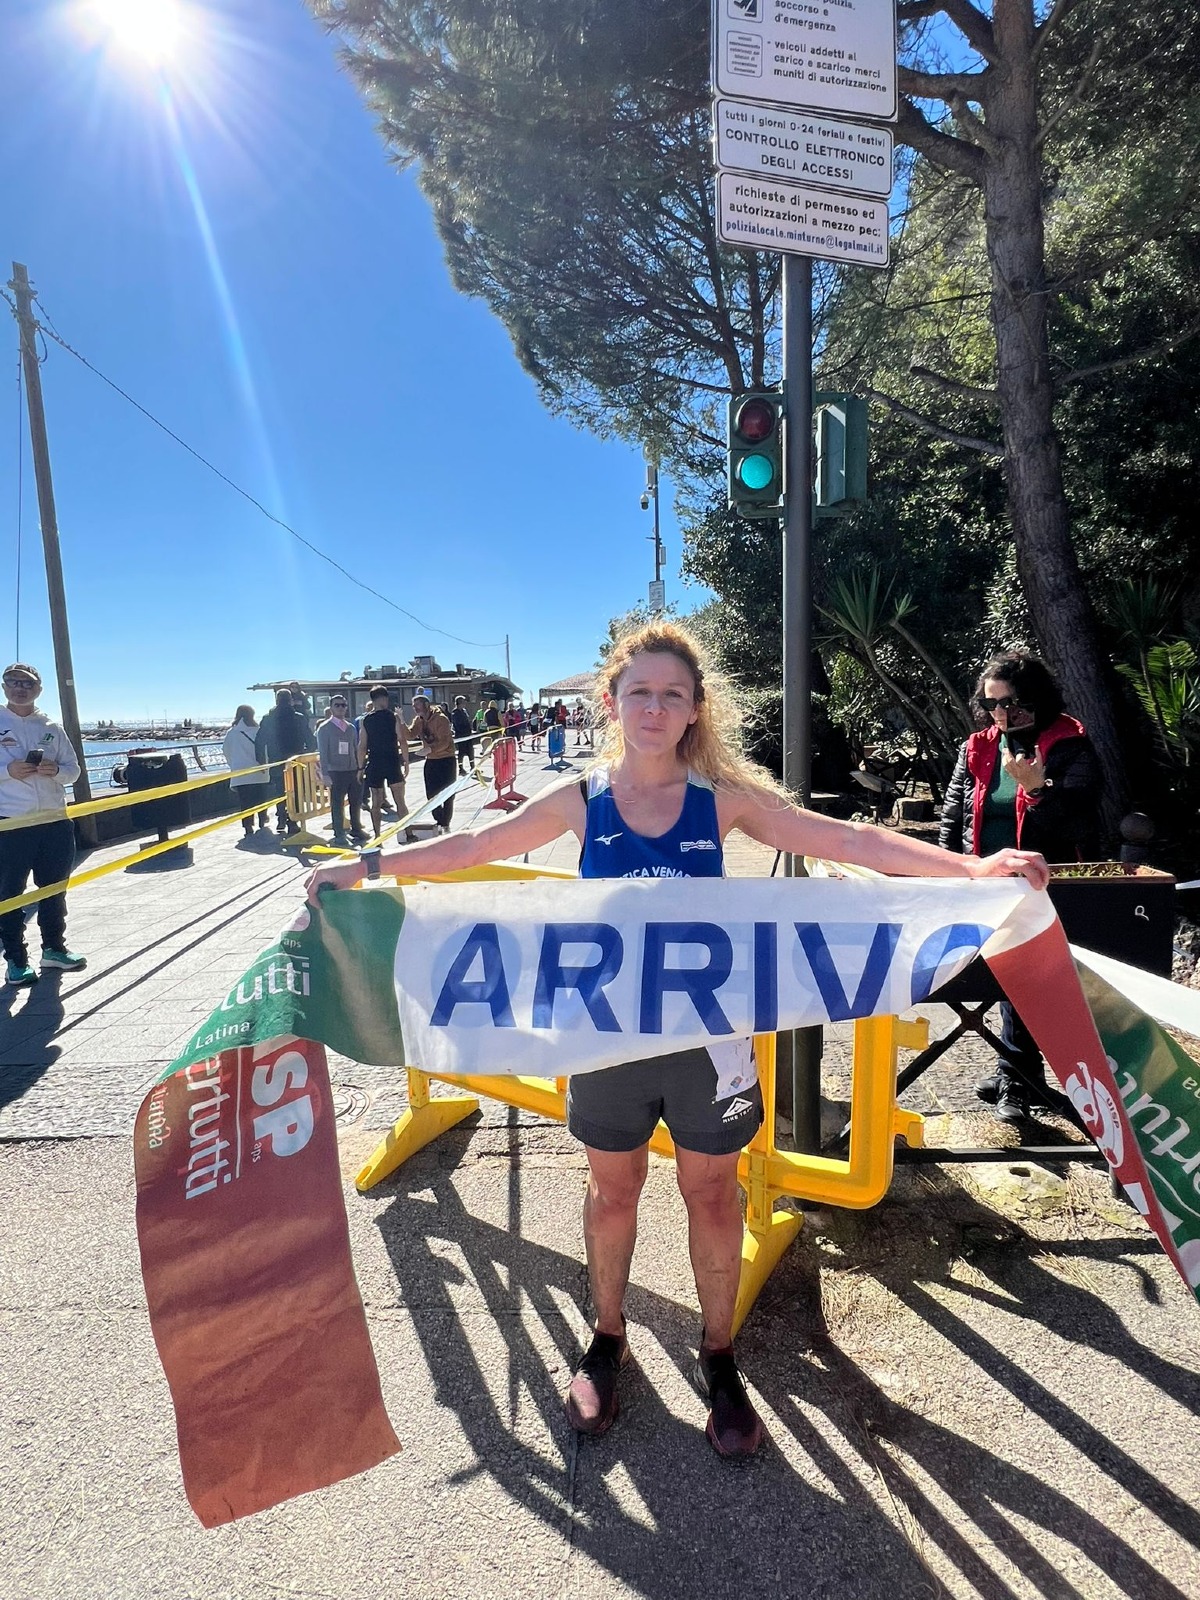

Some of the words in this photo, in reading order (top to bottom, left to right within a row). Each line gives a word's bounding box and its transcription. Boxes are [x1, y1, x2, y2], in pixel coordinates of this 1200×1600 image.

[775, 0, 819, 14] soccorso
[775, 14, 836, 32] d'emergenza
[775, 40, 807, 53] veicoli
[811, 46, 845, 60] addetti
[848, 51, 857, 61] al
[774, 54, 804, 67] carico
[817, 61, 851, 73] scarico
[855, 67, 881, 78] merci
[774, 67, 805, 80] muniti
[808, 72, 817, 81] di
[820, 74, 887, 92] autorizzazione
[725, 110, 748, 122] tutti
[759, 117, 786, 129] giorni
[818, 126, 845, 140] feriali
[857, 134, 886, 147] festivi
[725, 128, 799, 151] CONTROLLO
[806, 143, 885, 166] ELETTRONICO
[761, 154, 796, 170] DEGLI
[802, 162, 854, 180] ACCESSI
[735, 185, 786, 203] richieste
[790, 194, 800, 206] di
[805, 199, 859, 217] permesso
[862, 209, 875, 220] ed
[729, 201, 808, 224] autorizzazioni
[812, 218, 818, 226] a
[822, 219, 855, 232] mezzo
[859, 226, 881, 237] pec:
[726, 220, 884, 255] polizialocale.minturno@legalmail.it
[195, 1021, 250, 1049] Latina
[1106, 1098, 1120, 1128] UISP
[252, 1141, 262, 1163] aps
